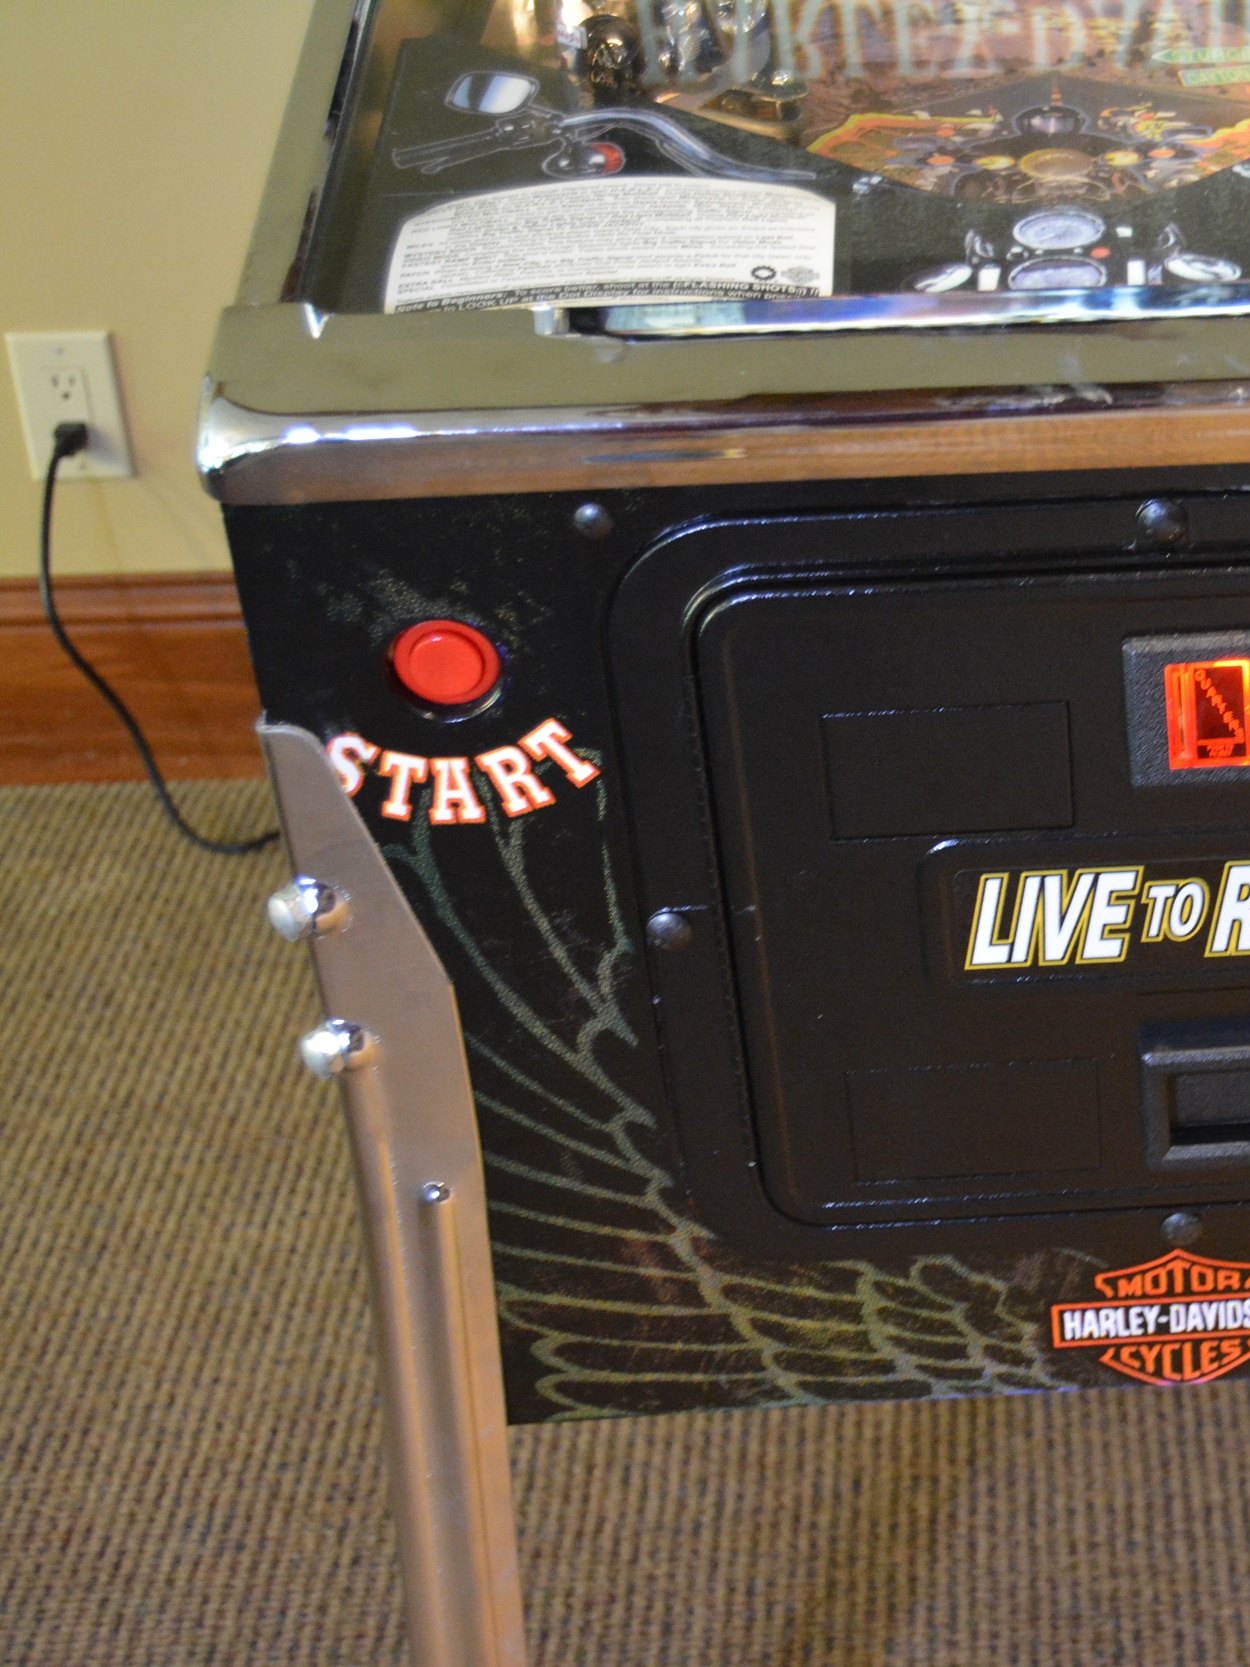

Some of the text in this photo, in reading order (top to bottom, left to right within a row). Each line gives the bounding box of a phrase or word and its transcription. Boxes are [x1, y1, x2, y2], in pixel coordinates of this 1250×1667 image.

[326, 717, 601, 825] START
[964, 866, 1145, 970] LIVE
[1141, 878, 1211, 943] TO
[1116, 1259, 1243, 1298] MOTOR
[1119, 1337, 1243, 1382] CYCLES
